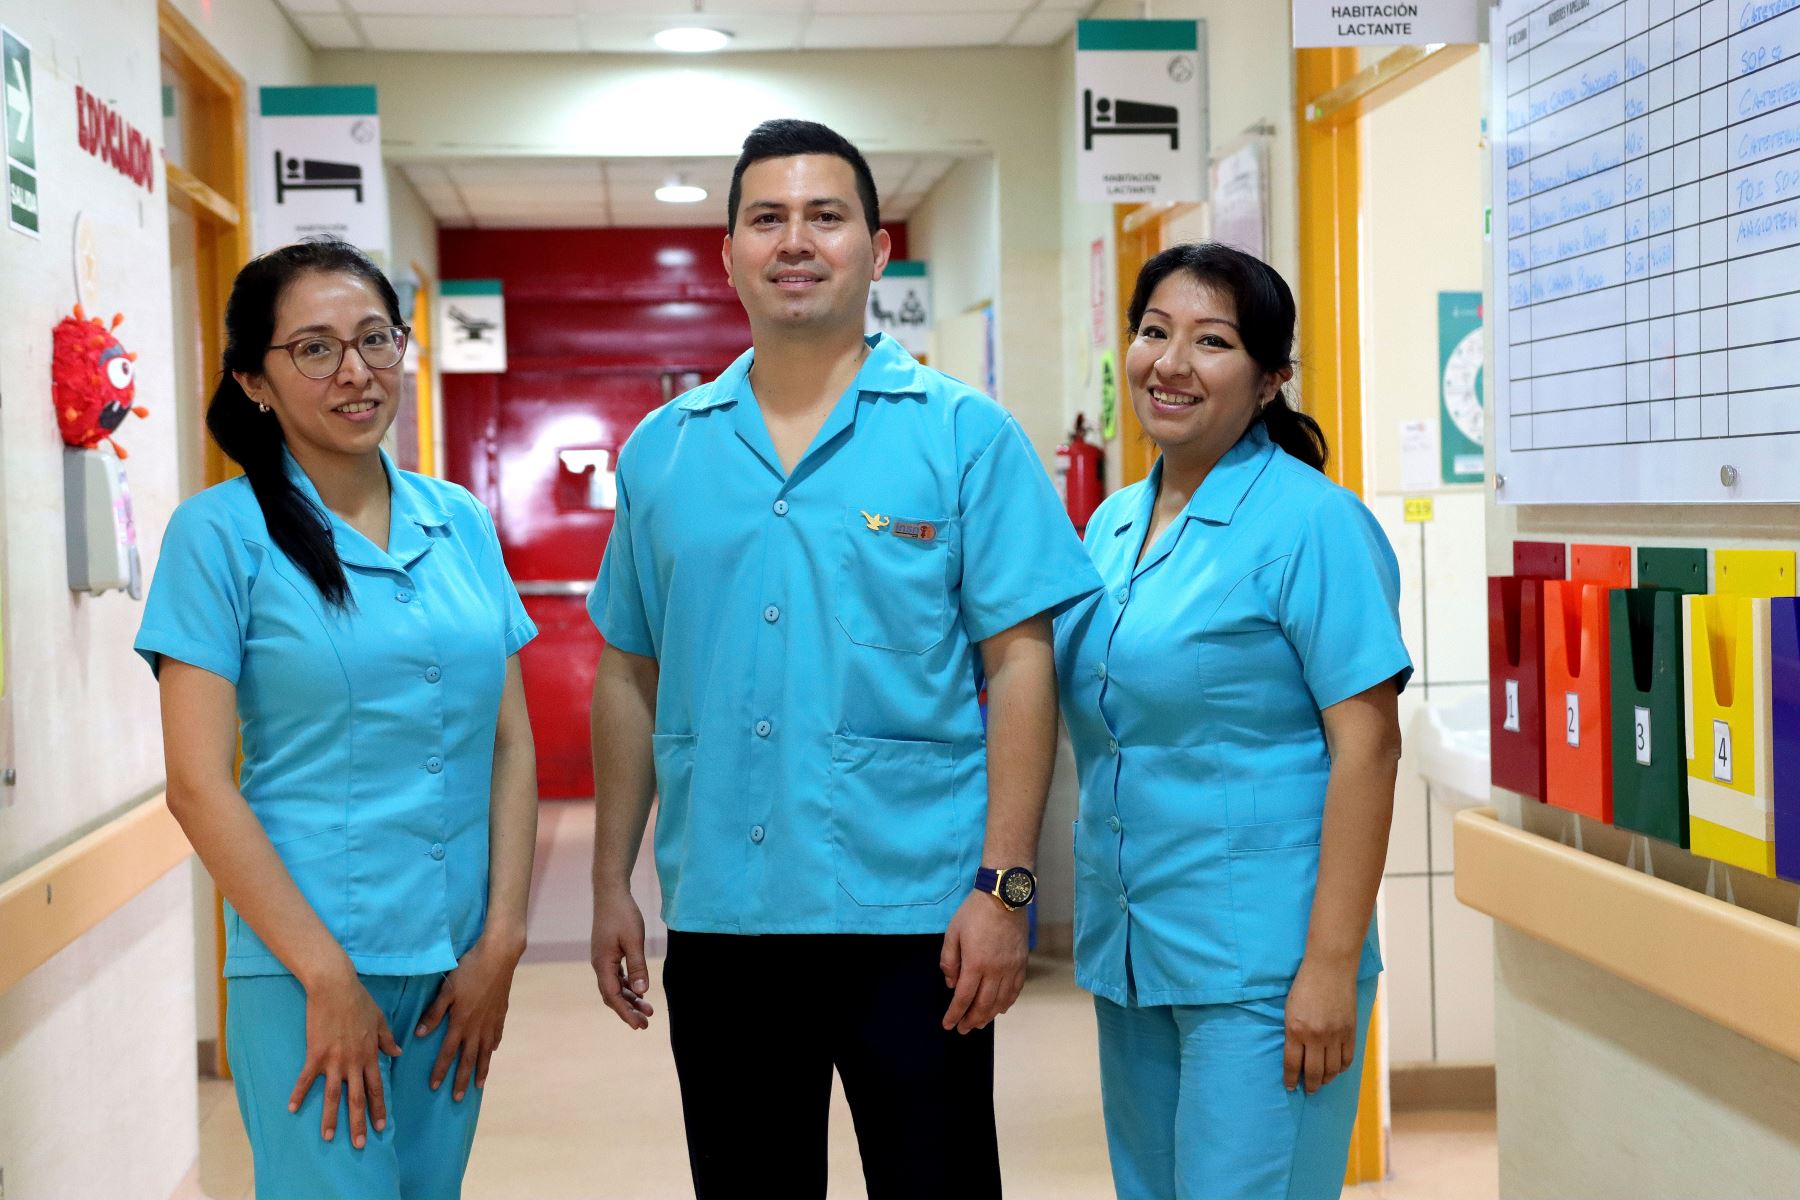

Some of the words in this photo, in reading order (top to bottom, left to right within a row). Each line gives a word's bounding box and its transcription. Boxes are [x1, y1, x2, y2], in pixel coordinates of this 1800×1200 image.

[1331, 4, 1418, 18] HABITACIÓN
[1338, 22, 1412, 36] LACTANTE
[1104, 172, 1161, 183] HABITACIÓN
[1107, 185, 1156, 195] LACTANTE
[10, 182, 37, 215] SALIDA
[1508, 694, 1515, 719] 1
[1568, 707, 1575, 733] 2
[1637, 723, 1645, 751] 3
[1718, 737, 1728, 768] 4
